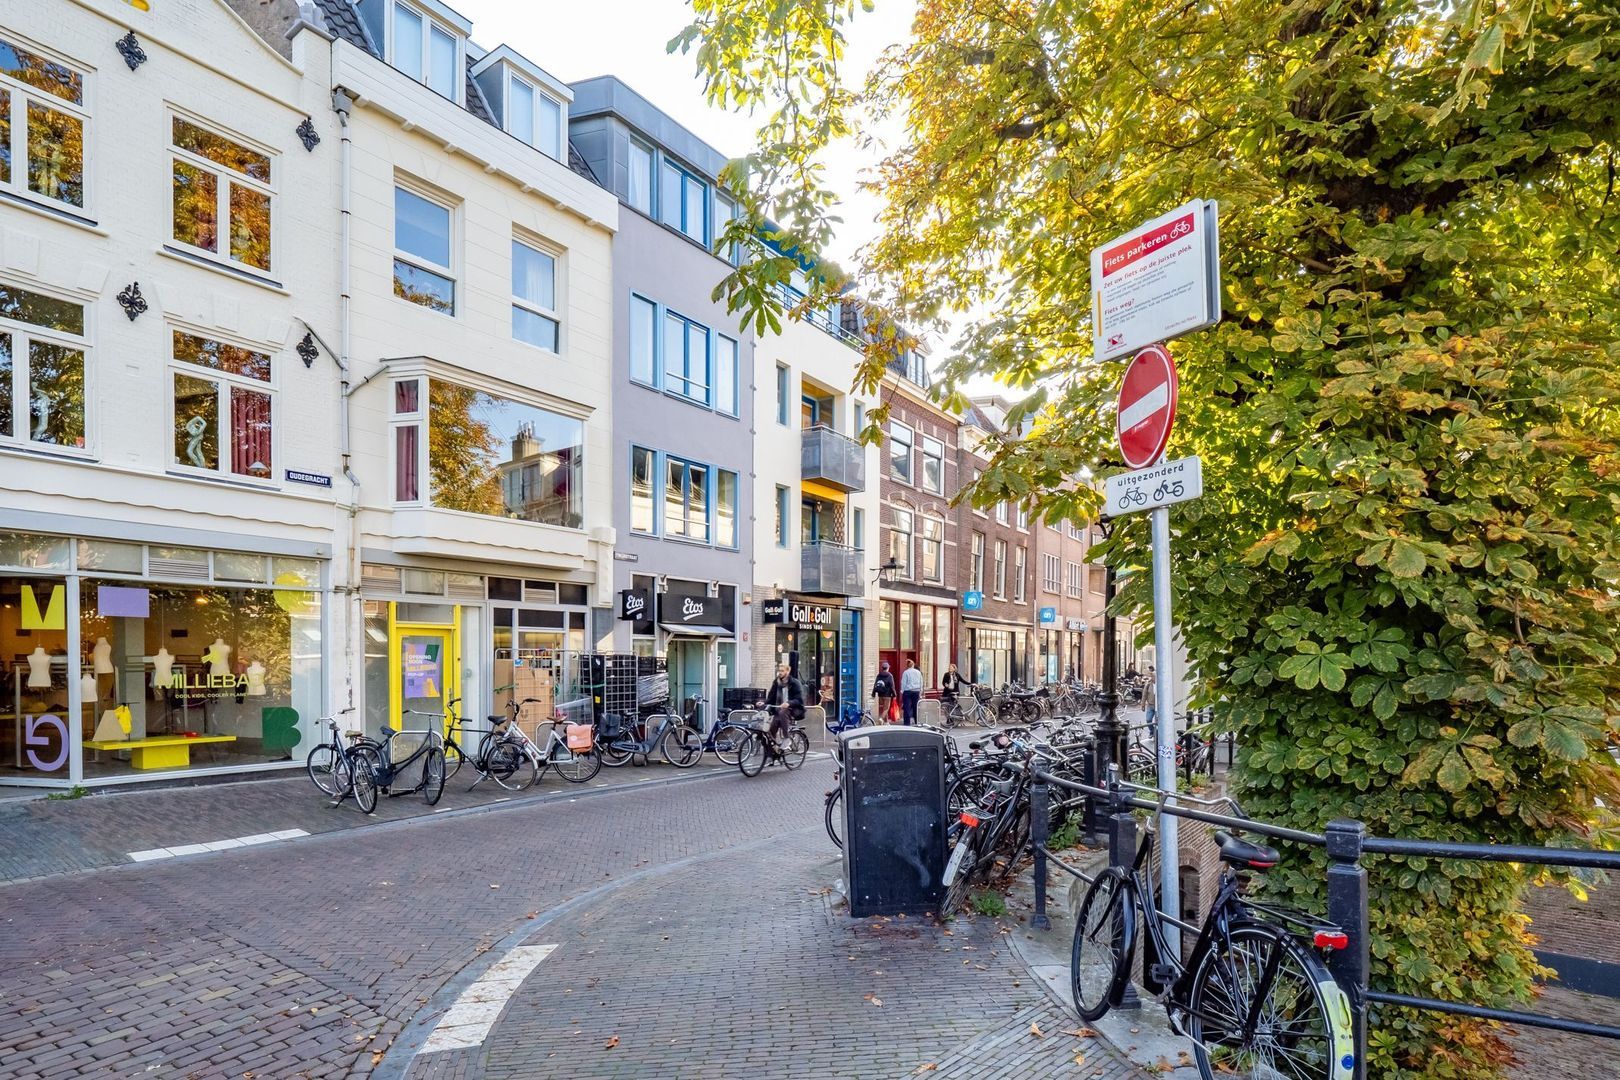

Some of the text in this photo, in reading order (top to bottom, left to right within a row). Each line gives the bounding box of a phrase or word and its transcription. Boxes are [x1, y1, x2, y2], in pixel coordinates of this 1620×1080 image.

[1104, 234, 1167, 269] Fiets parkeren
[1104, 280, 1113, 289] Zet
[1124, 268, 1138, 280] fiets
[1139, 265, 1148, 273] op
[1148, 260, 1157, 268] de
[1157, 252, 1176, 265] juiste
[1177, 244, 1192, 256] plek
[1104, 298, 1135, 316] Fiets weg?
[289, 472, 328, 484] OUDEGRACHT
[1117, 463, 1184, 487] uitgezonderd
[626, 595, 644, 609] Etos
[682, 597, 704, 614] Etos
